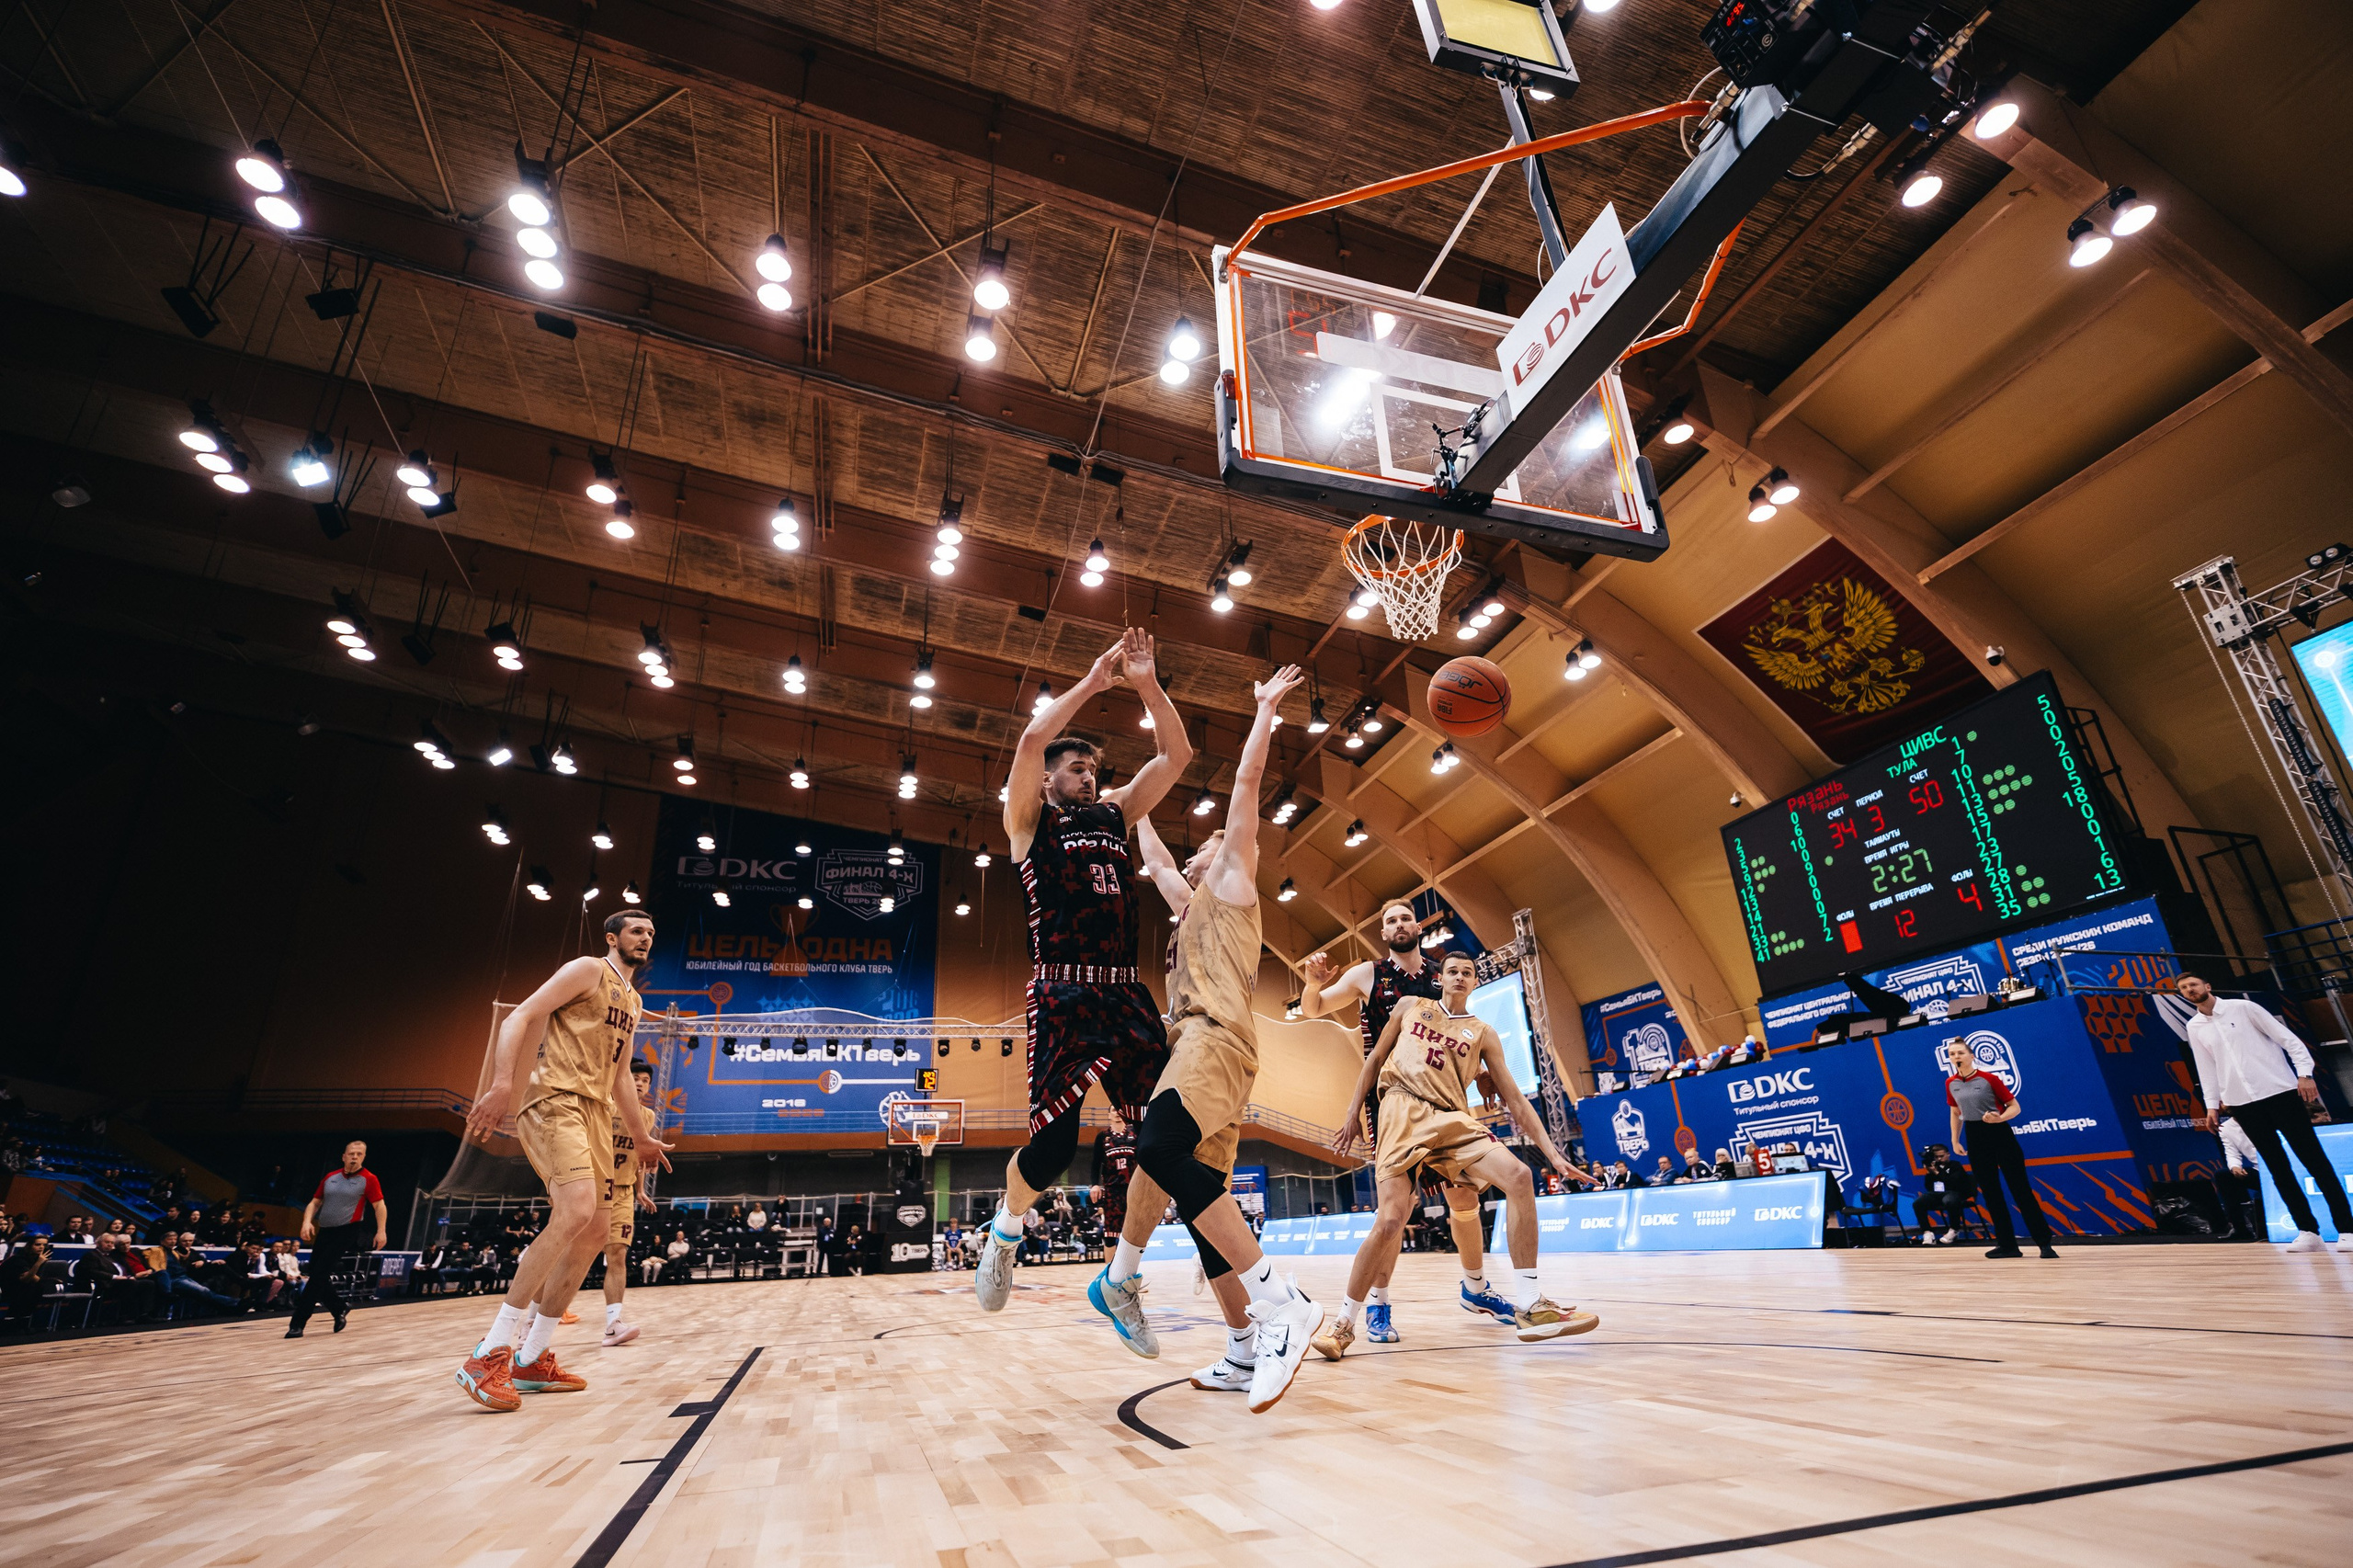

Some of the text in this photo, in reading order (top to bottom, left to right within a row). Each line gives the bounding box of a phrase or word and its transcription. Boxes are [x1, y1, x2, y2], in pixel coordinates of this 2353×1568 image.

[1544, 247, 1617, 348] DKC
[2037, 694, 2050, 710] 5
[2043, 710, 2056, 725] 0
[2050, 725, 2062, 740] 0
[1900, 726, 1947, 758] ЦИВС
[1951, 736, 1961, 749] 1
[2055, 740, 2069, 757] 2
[1955, 749, 1964, 764] 7
[2062, 756, 2075, 771] 0
[1886, 758, 1917, 778] ТУЛА
[1909, 768, 1928, 783] СЧЕТ
[1951, 764, 1972, 783] 10
[1956, 779, 1975, 797] 11
[2068, 771, 2082, 788] 5
[1856, 790, 1883, 807] ПЕРИОД
[1909, 780, 1943, 814] 50
[1961, 793, 1983, 812] 13
[2063, 787, 2088, 807] 18
[1790, 812, 1799, 824] 0
[1827, 806, 1845, 820] СЧЕТ
[1868, 805, 1884, 832] 3
[1967, 808, 1988, 826] 15
[2081, 802, 2094, 819] 0
[1794, 824, 1802, 836] 6
[1828, 818, 1858, 848] 34
[1972, 822, 1991, 841] 17
[2087, 819, 2101, 835] 0
[1734, 837, 1743, 851] 2
[1790, 836, 1806, 852] 10
[1976, 837, 1999, 858] 23
[2095, 836, 2105, 851] 1
[1737, 849, 1745, 862] 3
[1802, 849, 1810, 862] 0
[1864, 841, 1909, 864] ВРЕМЯ ИГРЫ
[2100, 852, 2114, 869] 6
[719, 858, 798, 881] DKC
[1741, 861, 1749, 874] 5
[1805, 862, 1813, 875] 9
[1870, 848, 1933, 893] 2:27
[1982, 852, 2002, 872] 27
[825, 866, 884, 880] ФИНАЛ
[1089, 864, 1120, 894] 33
[1744, 873, 1752, 885] 9
[1809, 875, 1817, 888] 0
[1986, 869, 2010, 888] 28
[2094, 869, 2121, 889] 13
[676, 881, 797, 893] Титульй спонсор
[1741, 885, 1756, 900] 12
[1813, 888, 1821, 901] 0
[1992, 884, 2014, 903] 31
[843, 896, 870, 904] ТВЕРЬ
[1744, 897, 1758, 913] 13
[1869, 897, 1893, 911] ВРЕМЯ
[1957, 883, 1983, 912] 4
[1816, 901, 1824, 914] 0
[1997, 900, 2021, 919] 35
[1747, 910, 1763, 925] 14
[1819, 914, 1827, 927] 7
[1894, 909, 1918, 938] 12
[1749, 923, 1764, 937] 21
[1824, 927, 1834, 941] 2
[2012, 939, 2047, 957] СРЕДИ
[2102, 914, 2154, 934] КОМАНД
[688, 934, 893, 962] ЦЕЛЬ ОДНА
[1753, 935, 1768, 950] 33
[1756, 948, 1770, 962] 41
[686, 960, 892, 974] ЮБИЛЕЙНЫЙ ГОД БАСКЕТБОЛЬНОГО КЛУБА ТВЕРЬ
[1901, 967, 1954, 985] ЧЕМПИОНАТ ЦФО
[1901, 982, 1944, 1003] ИНАЛ
[1764, 991, 1858, 1019] ЧЕМПИОНАТ ЦЕНТРАЛЬНОГ
[605, 1006, 634, 1034] ЦИВ
[1767, 1003, 1847, 1028] ФЕДЕРАЛЬНОГО ОКРУГА
[1410, 1022, 1471, 1058] ЦИВС
[1426, 1047, 1445, 1072] 15
[1754, 1068, 1814, 1098] DKC
[1733, 1096, 1819, 1117] Титульный спонсор
[2132, 1094, 2190, 1119] ЦЕЛЬ
[1752, 1127, 1793, 1140] ЧЕМПИОНАТ
[2011, 1118, 2097, 1135] ьяБКТверь
[1617, 1140, 1650, 1154] ТВЕРЬ
[1116, 1158, 1127, 1170] 12
[1758, 1153, 1771, 1170] 5
[604, 1178, 614, 1201] 3
[1549, 1178, 1559, 1191] 5
[1654, 1213, 1679, 1225] DKC
[1769, 1206, 1803, 1221] DKC
[1590, 1217, 1614, 1229] DKC
